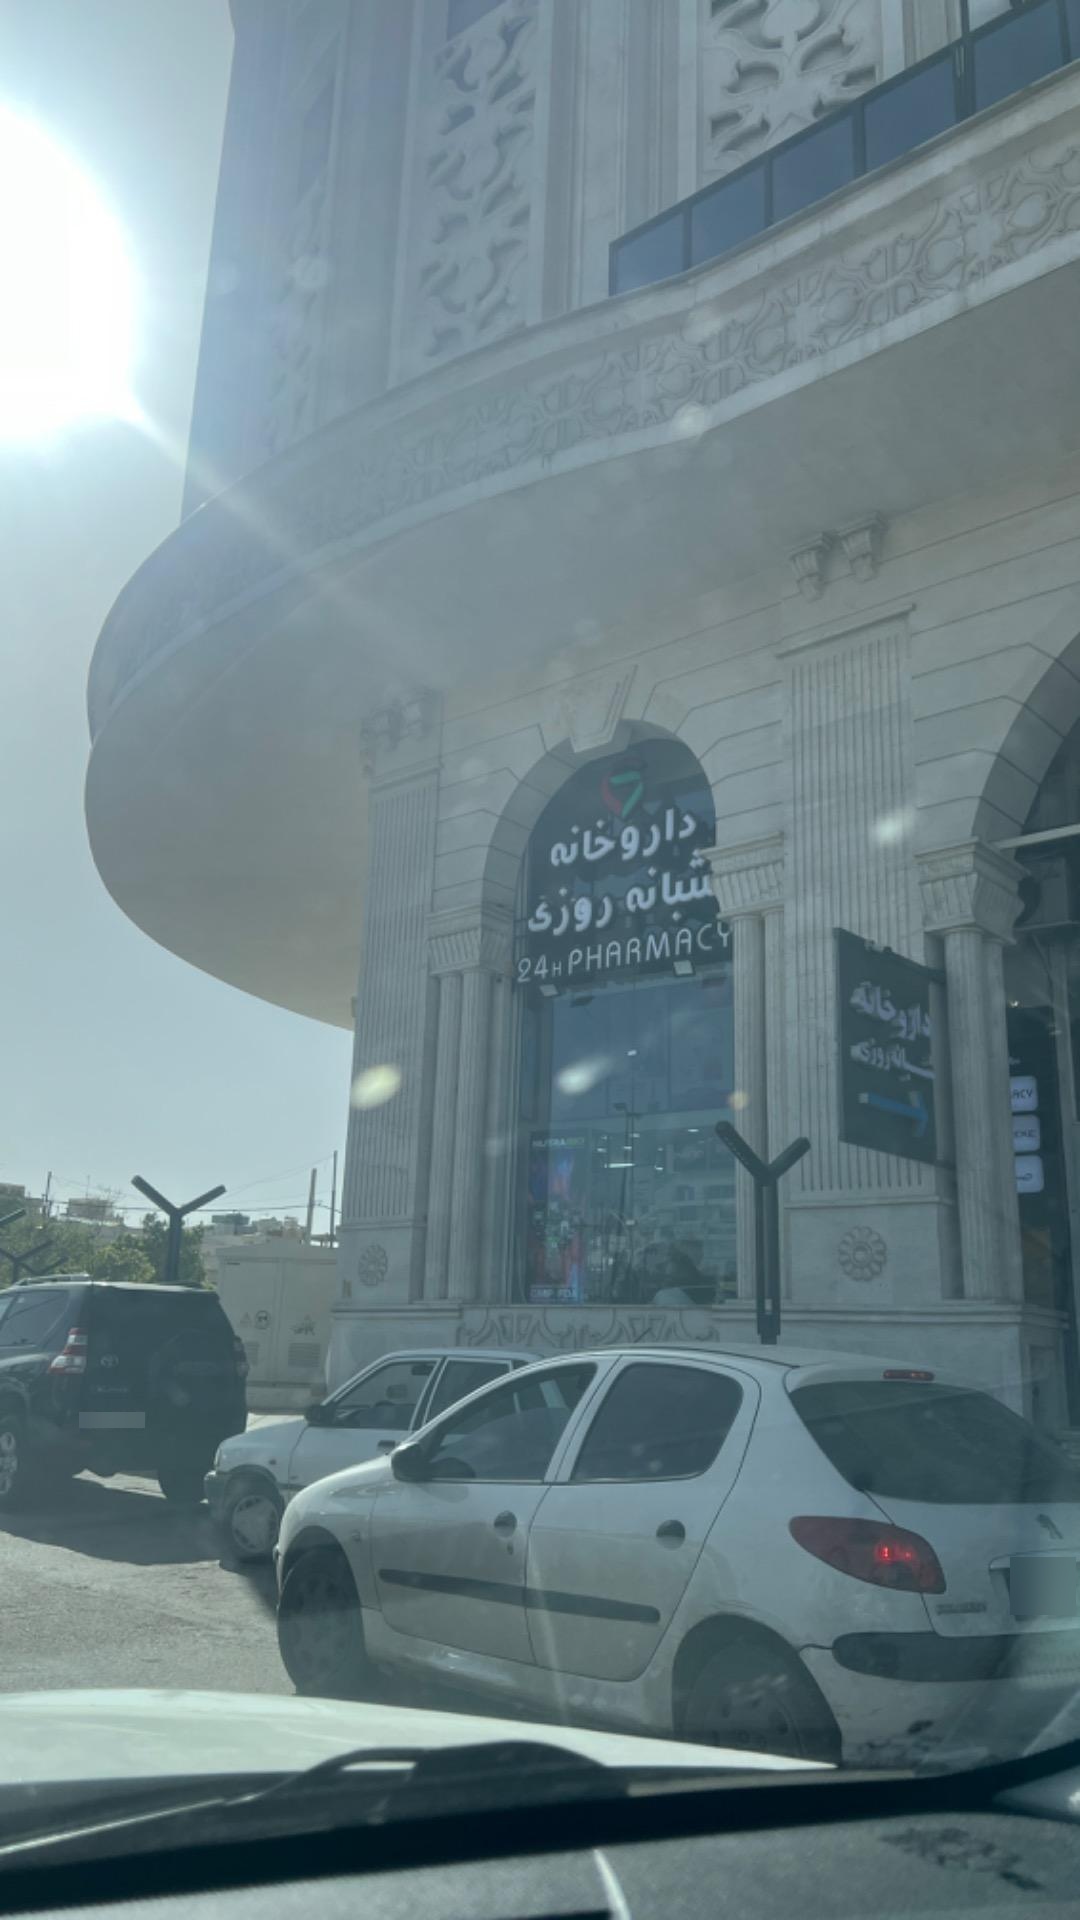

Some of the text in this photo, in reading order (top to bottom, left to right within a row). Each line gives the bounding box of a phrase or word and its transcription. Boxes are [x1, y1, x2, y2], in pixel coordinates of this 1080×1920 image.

[551, 808, 697, 866] داروخانه
[528, 848, 713, 936] شبانه روزی
[517, 920, 732, 983] 24H PHARMACY
